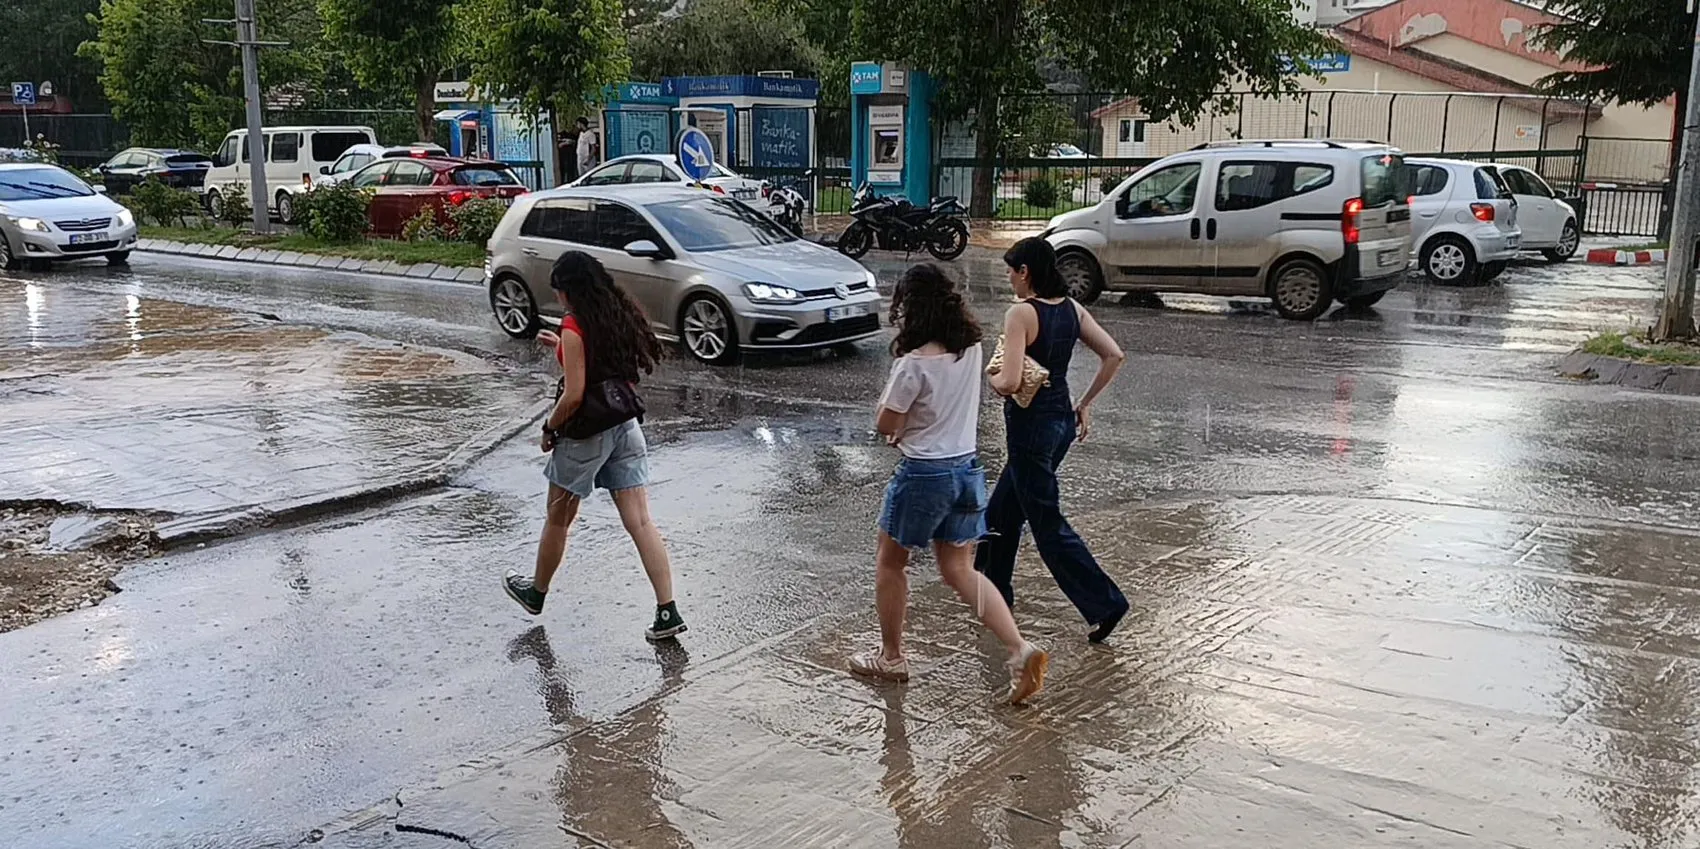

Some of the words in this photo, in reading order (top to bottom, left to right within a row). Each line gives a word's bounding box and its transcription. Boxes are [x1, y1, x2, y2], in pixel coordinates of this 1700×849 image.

[861, 71, 879, 80] TAM
[14, 84, 23, 97] P
[640, 86, 660, 97] TAM
[763, 81, 802, 93] Bankamatik
